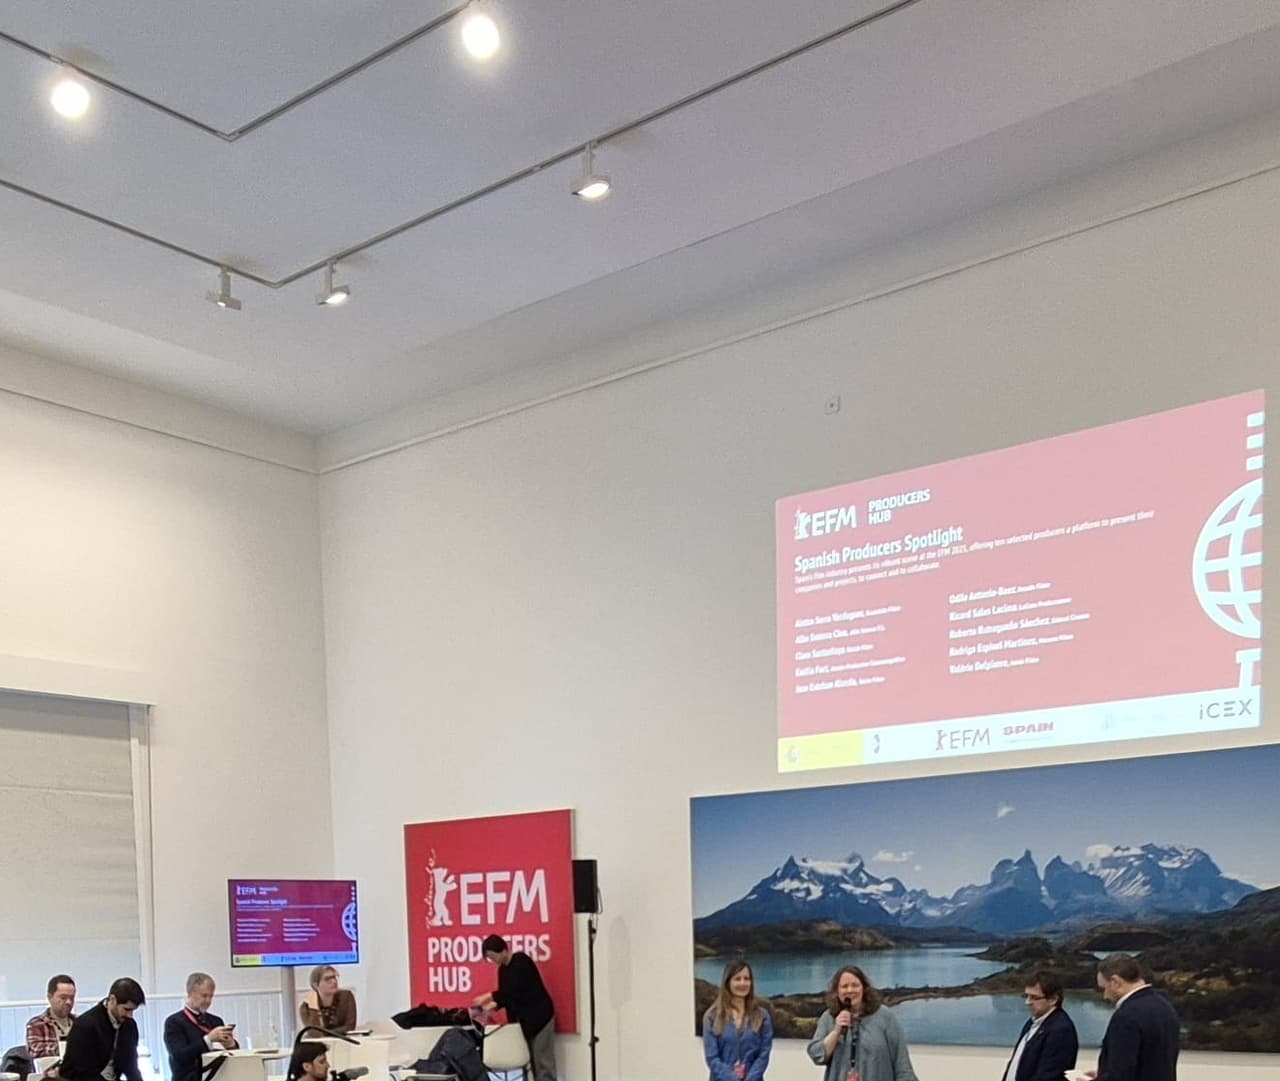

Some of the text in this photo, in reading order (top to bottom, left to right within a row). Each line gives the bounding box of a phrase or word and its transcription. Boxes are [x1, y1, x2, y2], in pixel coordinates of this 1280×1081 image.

[868, 489, 931, 513] PRODUCERS
[811, 505, 857, 537] EFM
[868, 510, 892, 525] HUB
[794, 526, 963, 573] Spanish Producers Spotlight
[949, 721, 1054, 750] EFM SPAIN
[460, 868, 549, 925] EFM
[429, 966, 472, 992] HUB
